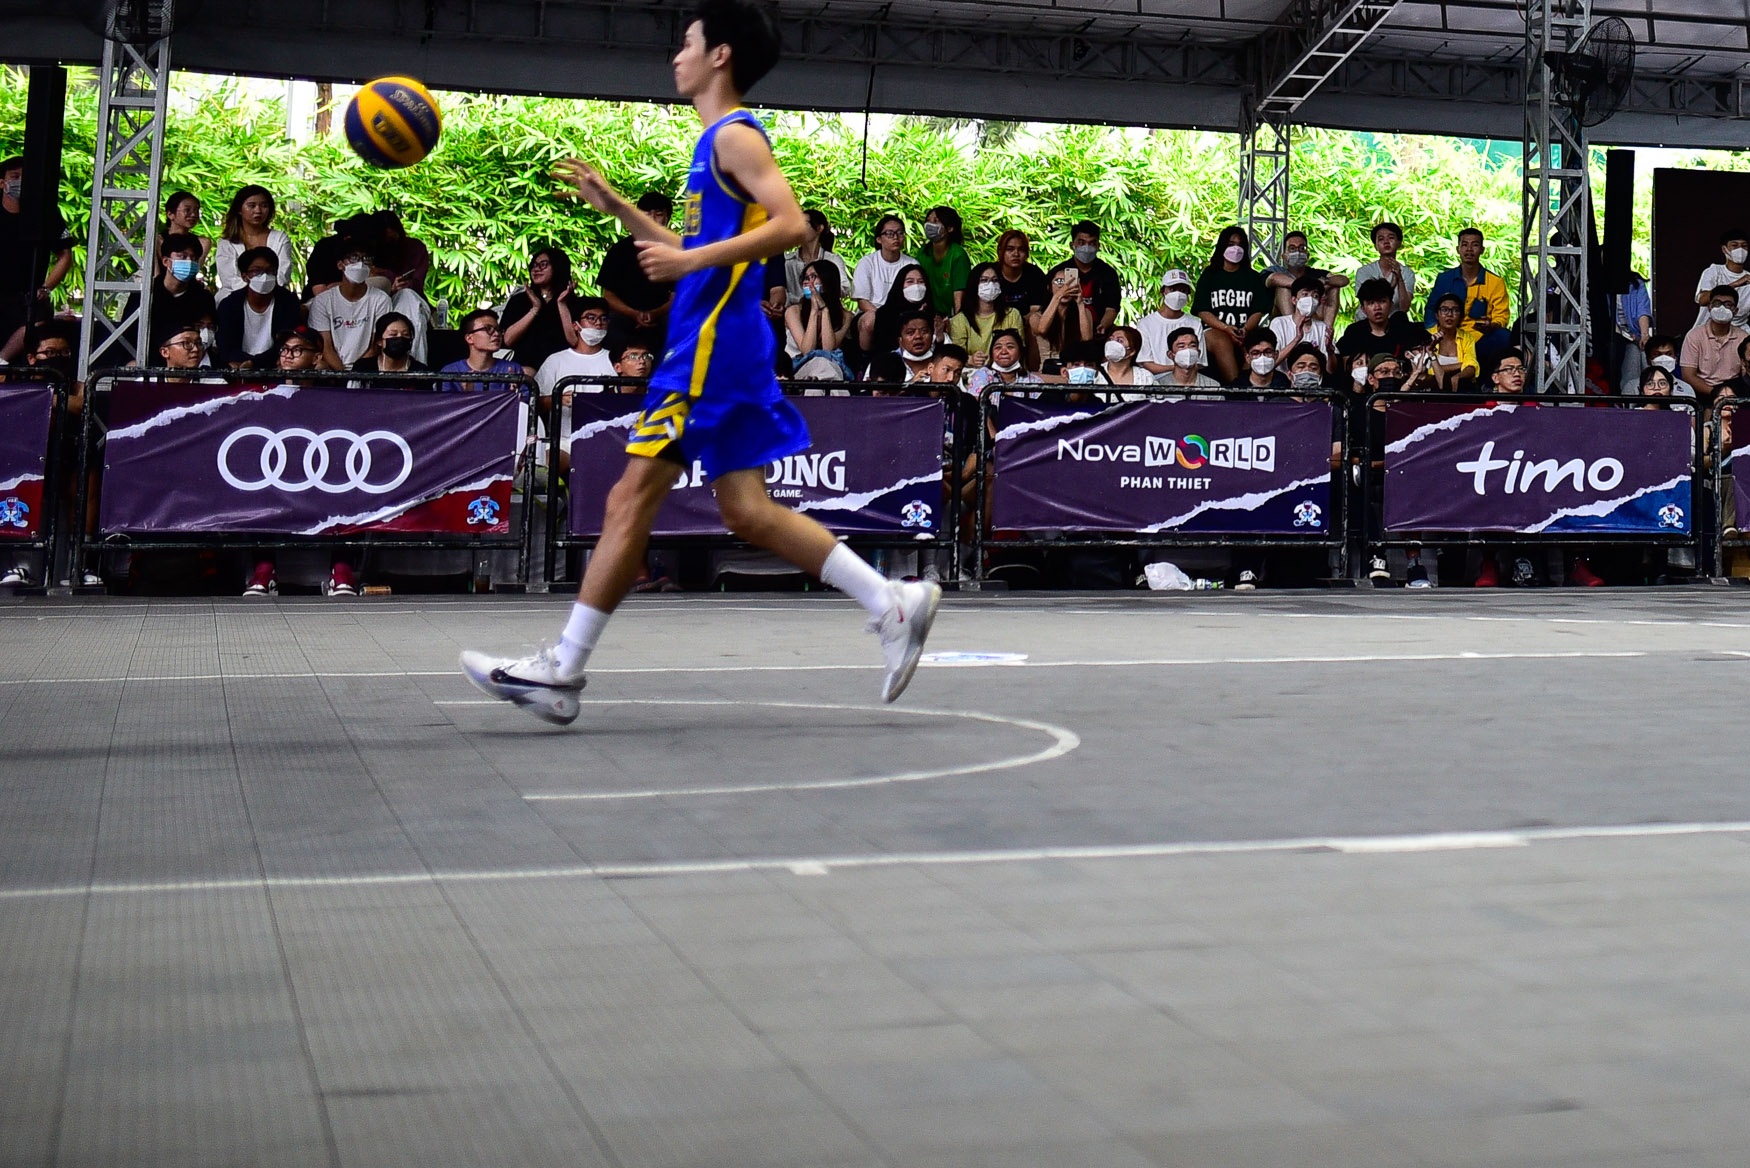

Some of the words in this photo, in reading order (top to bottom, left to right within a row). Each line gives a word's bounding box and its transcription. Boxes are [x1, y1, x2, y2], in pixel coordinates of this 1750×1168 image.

[1120, 475, 1163, 489] PHAN
[1167, 476, 1212, 490] THIET
[1455, 440, 1625, 496] timo
